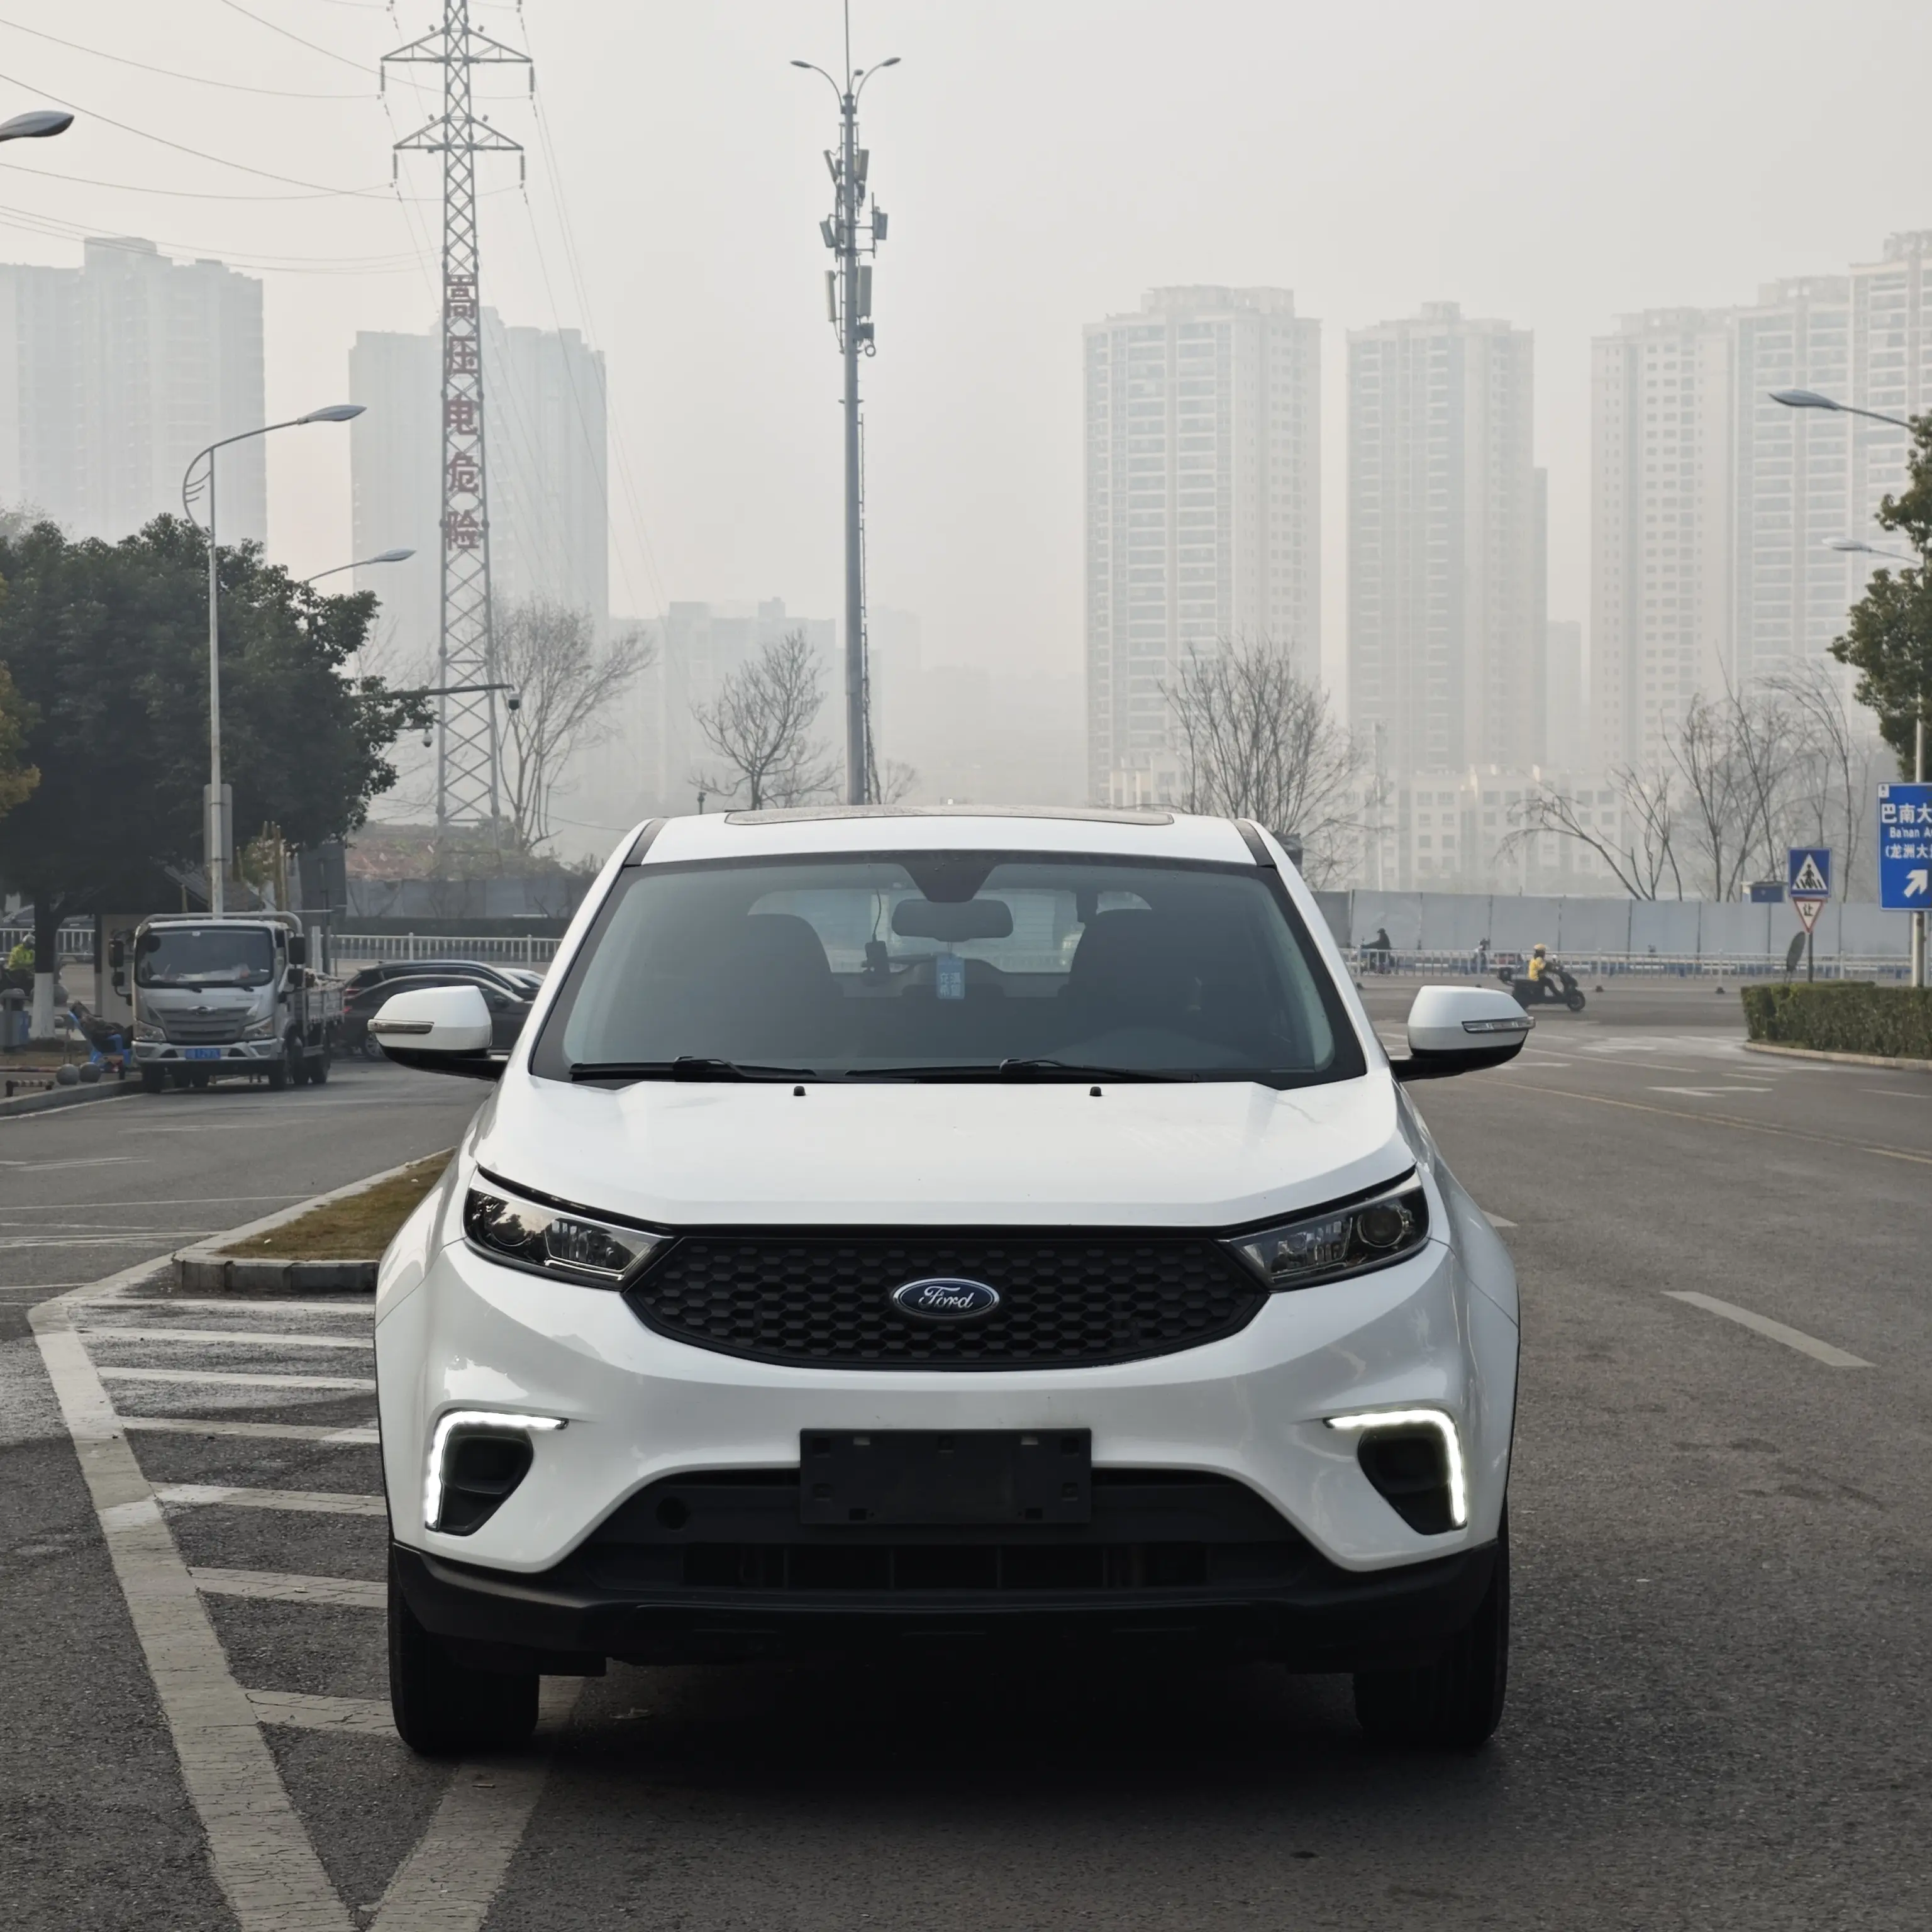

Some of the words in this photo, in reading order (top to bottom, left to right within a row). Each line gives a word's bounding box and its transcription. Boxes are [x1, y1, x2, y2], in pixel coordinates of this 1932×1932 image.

[447, 274, 479, 550] 高压电危险
[1885, 843, 1932, 858] (龙洲大
[1803, 903, 1814, 916] 让
[918, 1286, 975, 1309] Ford
